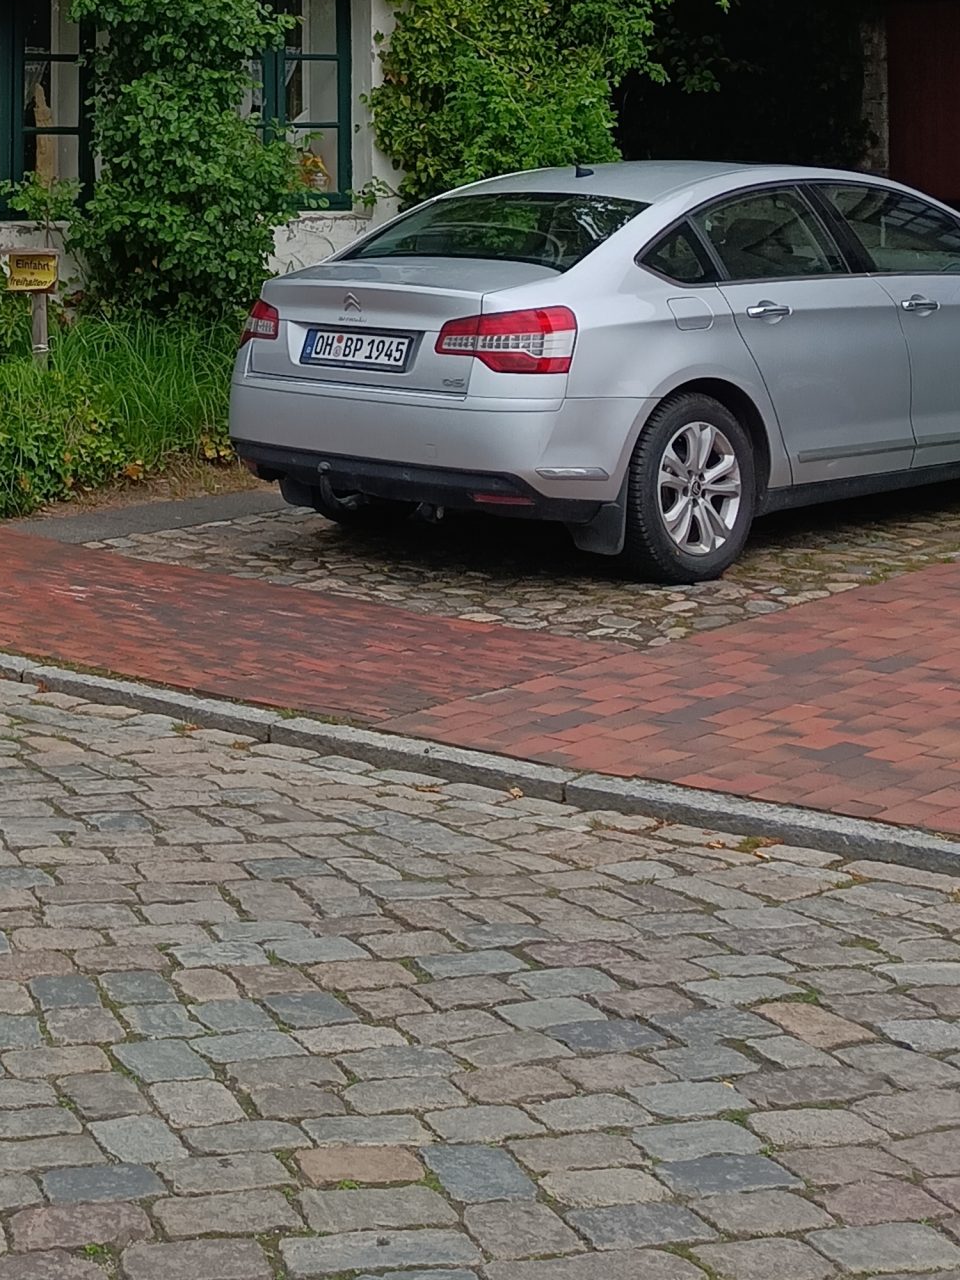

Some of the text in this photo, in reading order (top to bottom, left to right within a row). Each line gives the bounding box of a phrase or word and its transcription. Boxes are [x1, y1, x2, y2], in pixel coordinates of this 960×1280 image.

[15, 259, 50, 271] Einfahrt
[314, 335, 405, 362] OH BP 1945
